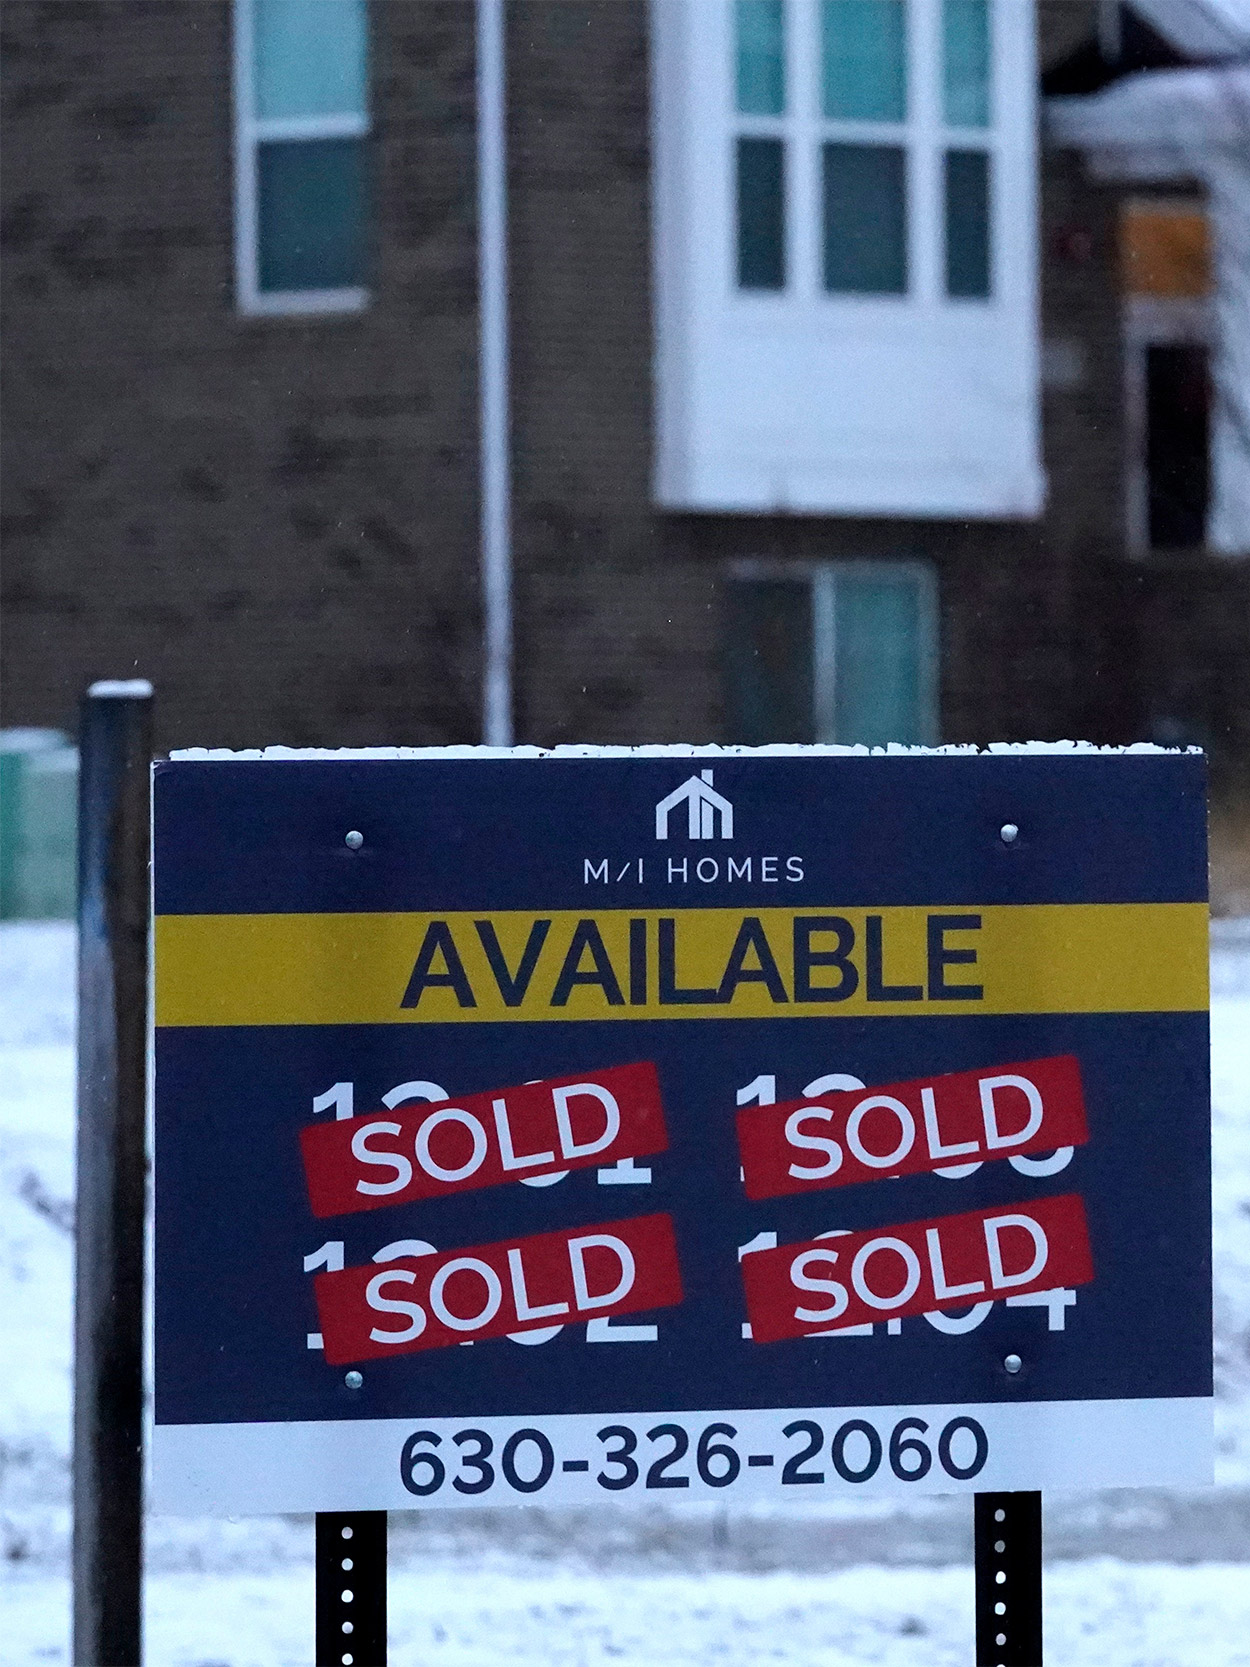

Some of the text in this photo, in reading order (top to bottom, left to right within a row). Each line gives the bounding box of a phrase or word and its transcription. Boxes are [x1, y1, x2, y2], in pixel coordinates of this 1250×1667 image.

[583, 856, 805, 885] M/I HOMES
[400, 914, 984, 1009] AVAILABLE
[350, 1082, 621, 1196] SOLD
[784, 1074, 1044, 1180] SOLD
[365, 1233, 636, 1345] SOLD
[789, 1213, 1049, 1323] SOLD
[400, 1416, 989, 1497] 630-326-2060
